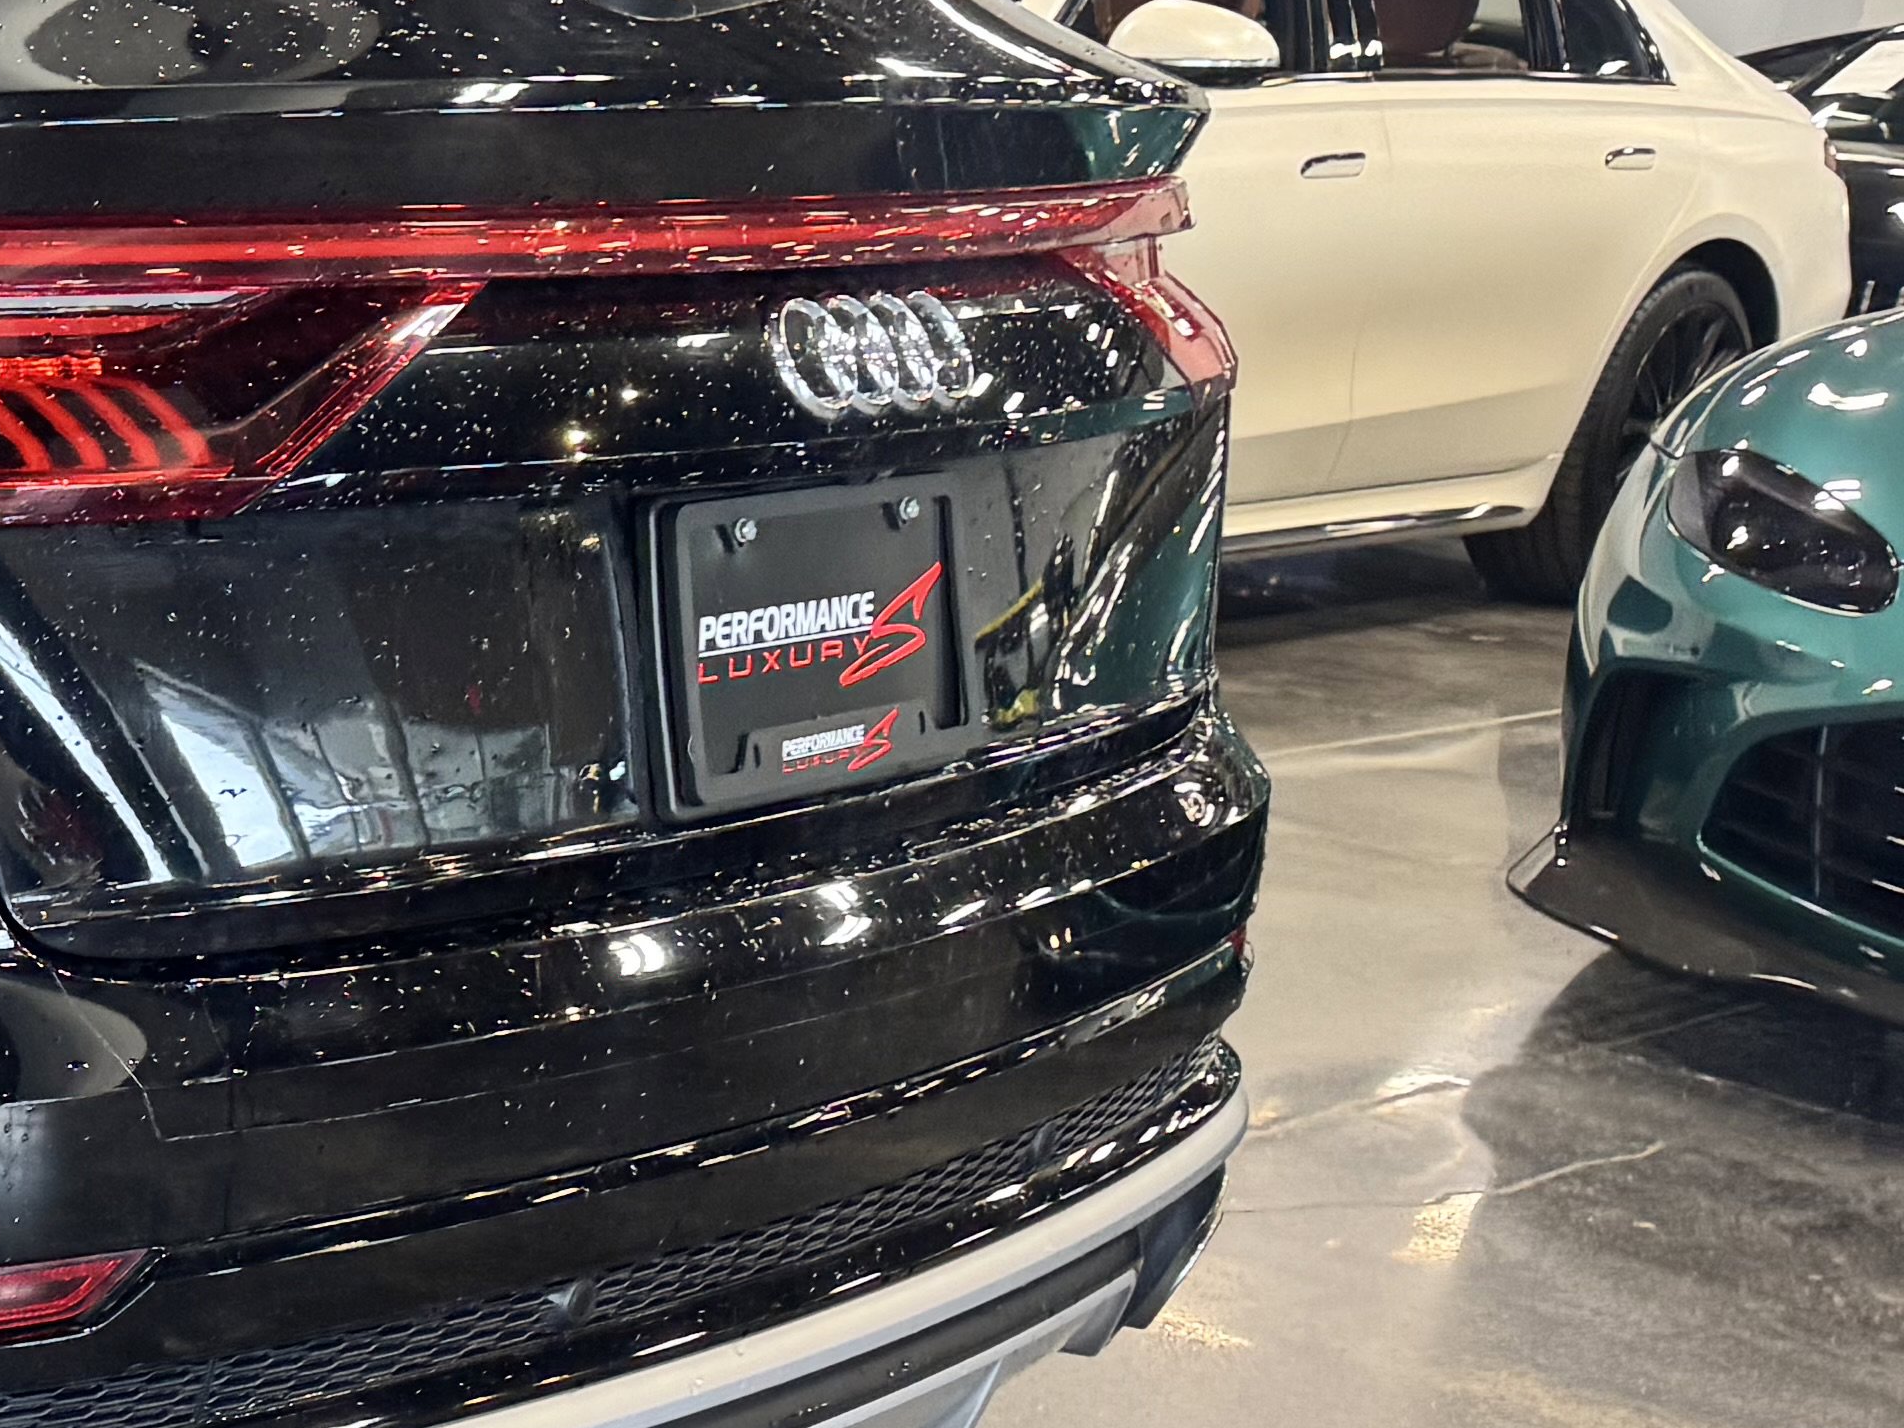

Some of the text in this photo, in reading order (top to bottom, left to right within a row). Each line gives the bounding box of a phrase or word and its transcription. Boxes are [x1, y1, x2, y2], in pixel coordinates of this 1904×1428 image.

[698, 591, 875, 652] PERFORMANCE
[698, 635, 872, 684] LUXURY
[782, 723, 865, 759] PERFORMANCE
